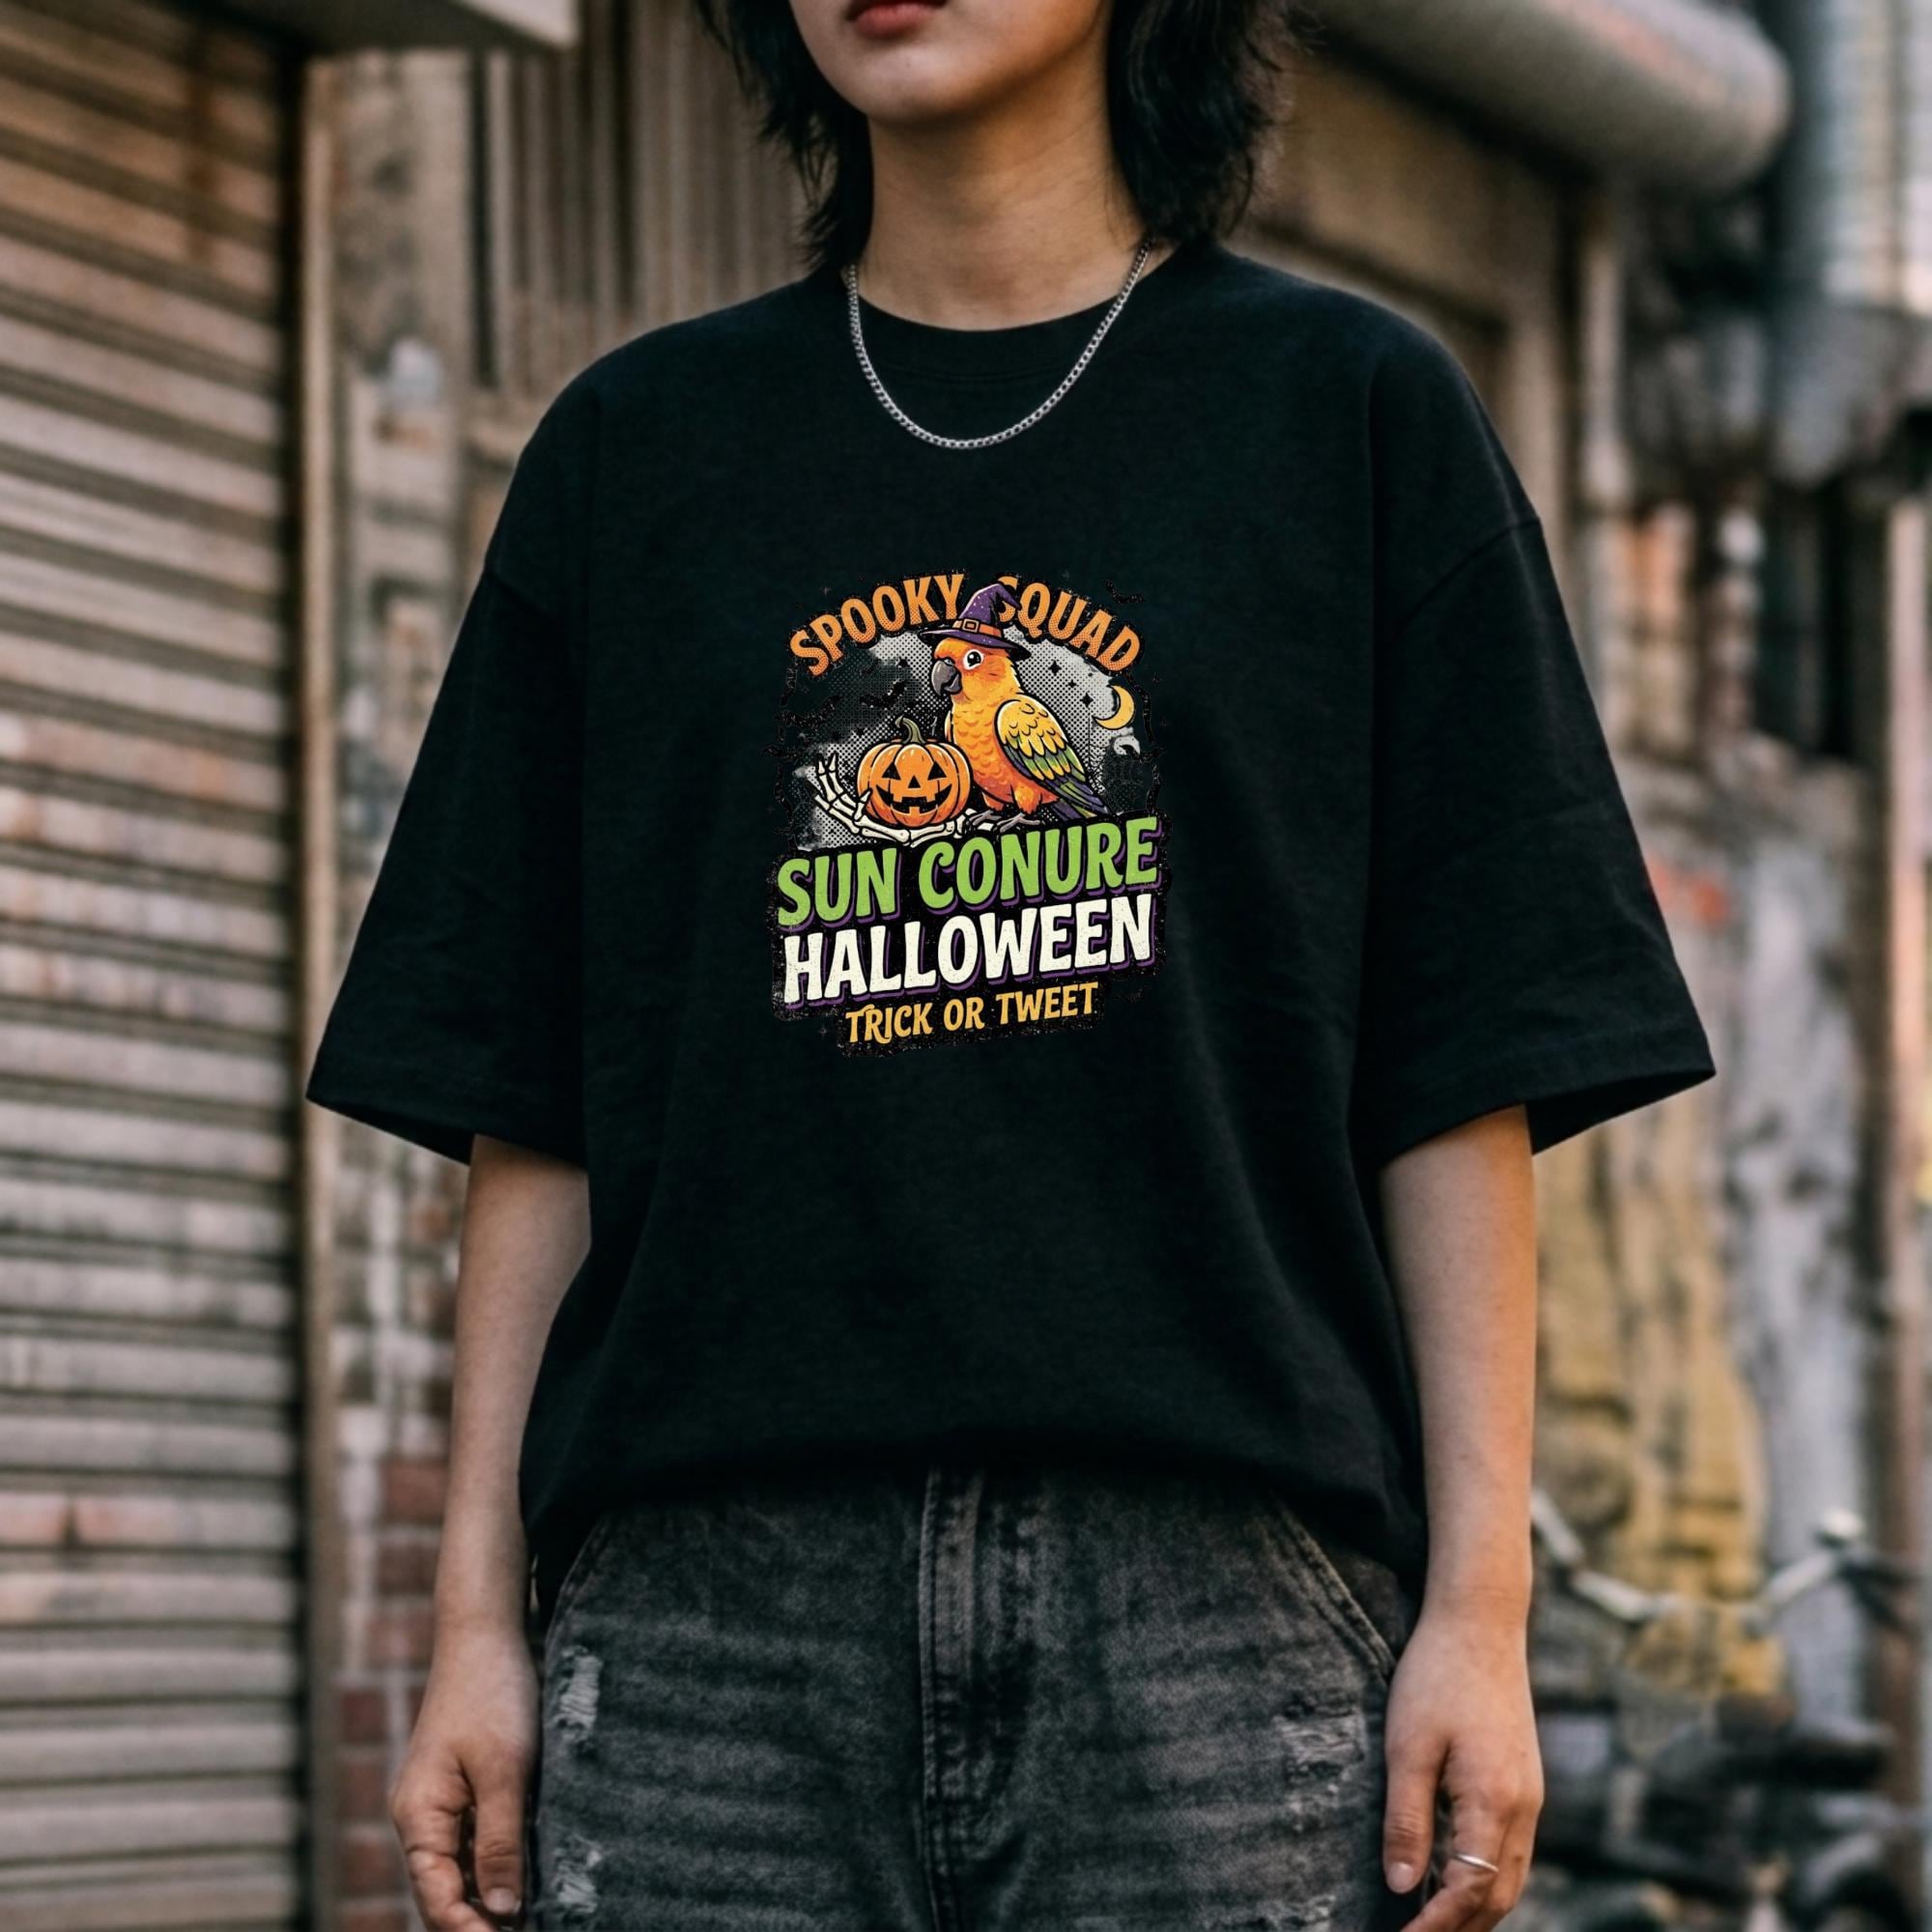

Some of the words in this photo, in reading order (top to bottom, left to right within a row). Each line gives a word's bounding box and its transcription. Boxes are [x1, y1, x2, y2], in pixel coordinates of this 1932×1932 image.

[789, 574, 964, 676] SPOOKY
[777, 847, 897, 927] SUN
[918, 816, 1158, 909] CONURE
[783, 894, 1152, 1004] HALLOWEEN
[845, 1003, 934, 1044] TRICK
[943, 996, 985, 1032] OR
[995, 981, 1099, 1025] TWEET
